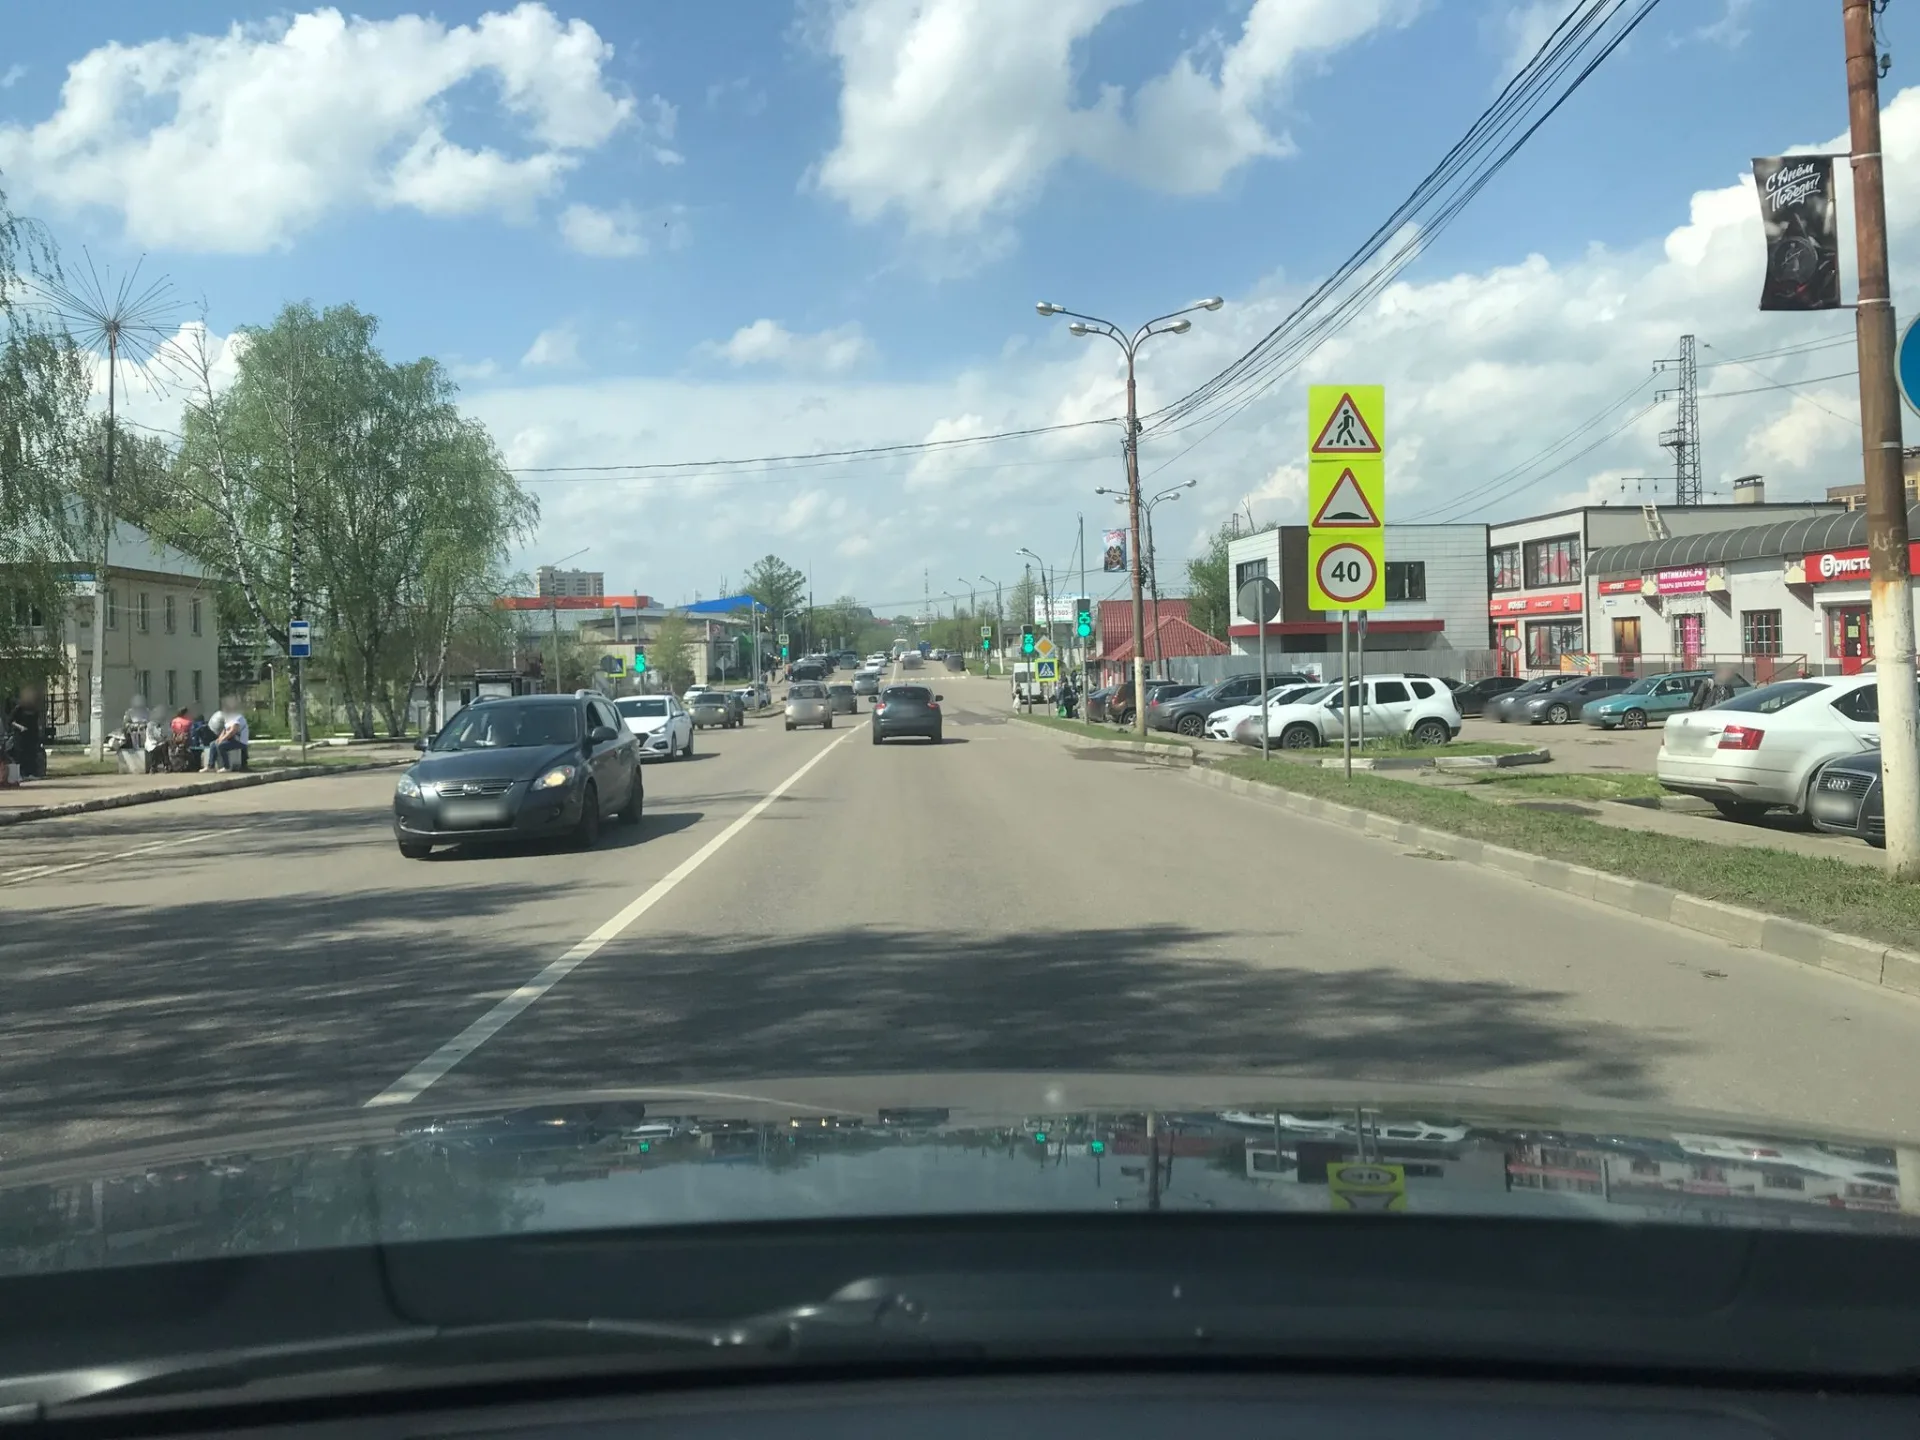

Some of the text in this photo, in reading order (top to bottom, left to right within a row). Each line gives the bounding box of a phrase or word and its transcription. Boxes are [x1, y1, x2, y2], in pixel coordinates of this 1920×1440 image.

[1766, 163, 1815, 192] С Днём
[1769, 174, 1821, 212] Победы!
[1331, 561, 1361, 582] 40
[1820, 554, 1871, 577] Бристо
